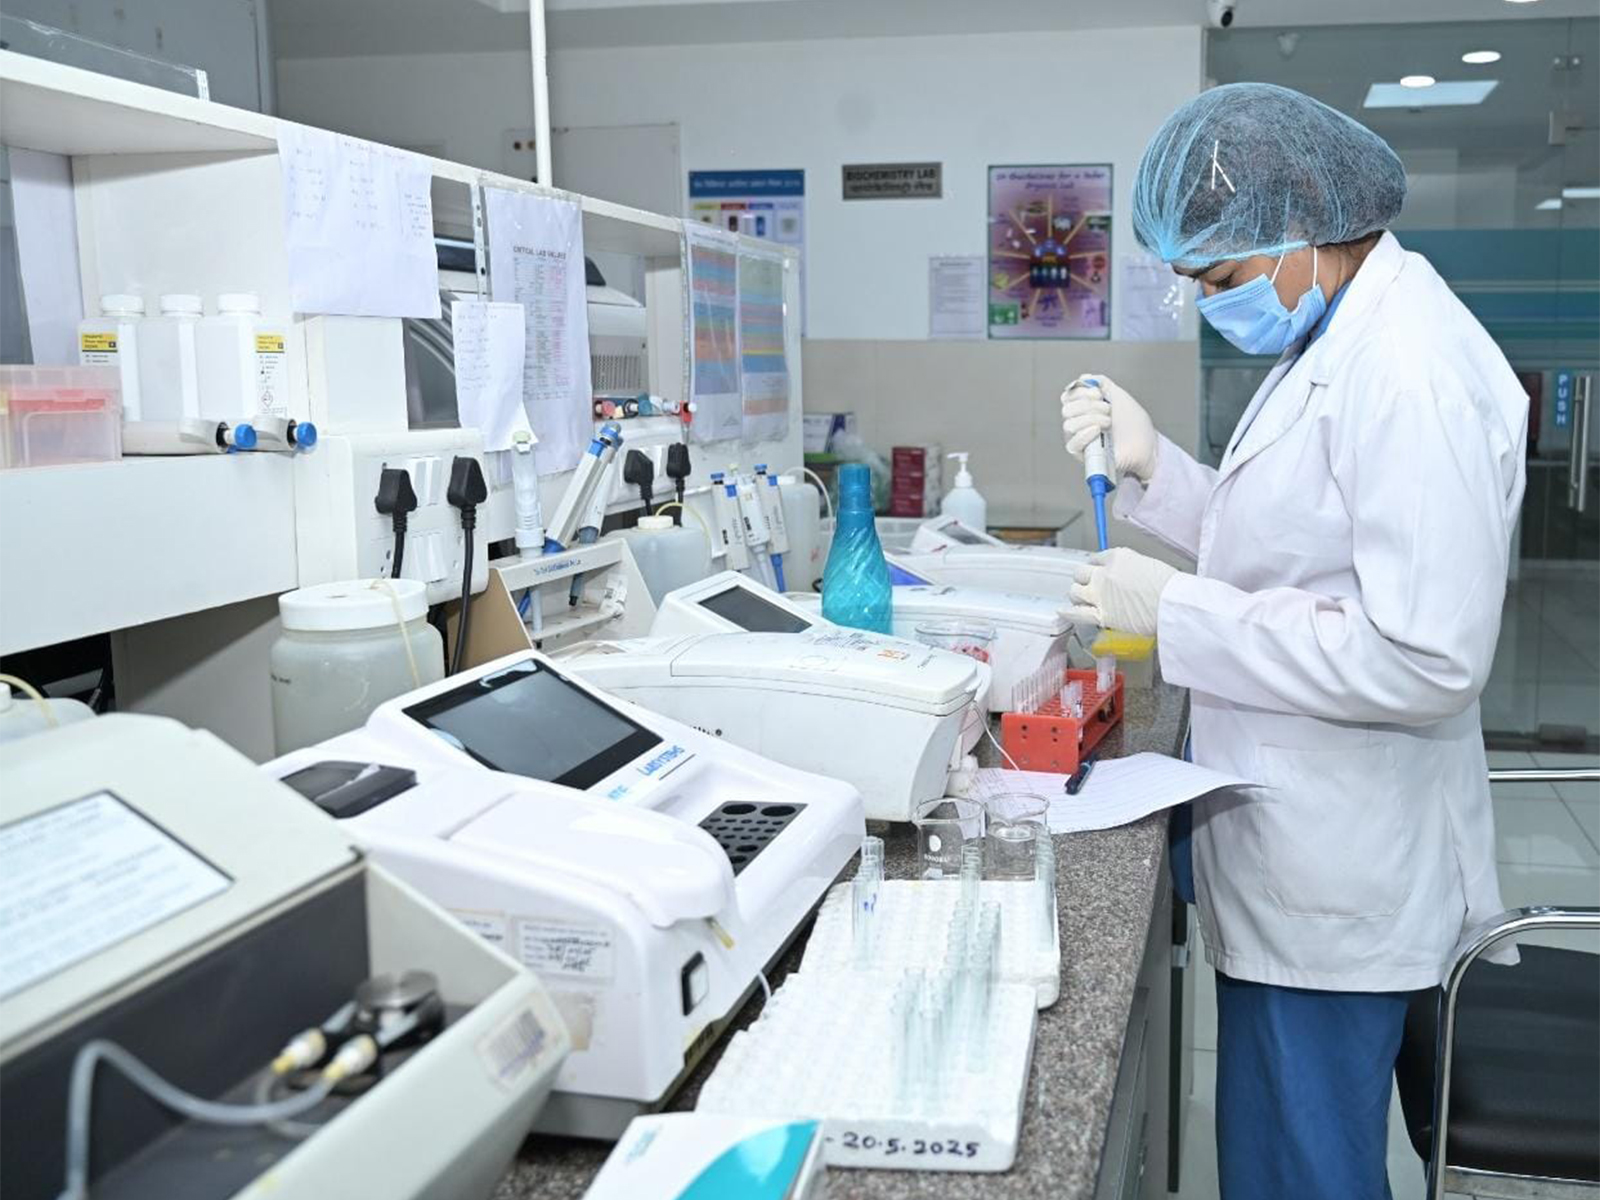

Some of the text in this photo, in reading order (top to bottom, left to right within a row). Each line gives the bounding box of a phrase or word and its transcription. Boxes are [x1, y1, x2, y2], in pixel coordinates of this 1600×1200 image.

[846, 167, 938, 181] BIOCHEMISTRY LAB
[1556, 373, 1569, 426] PUSH
